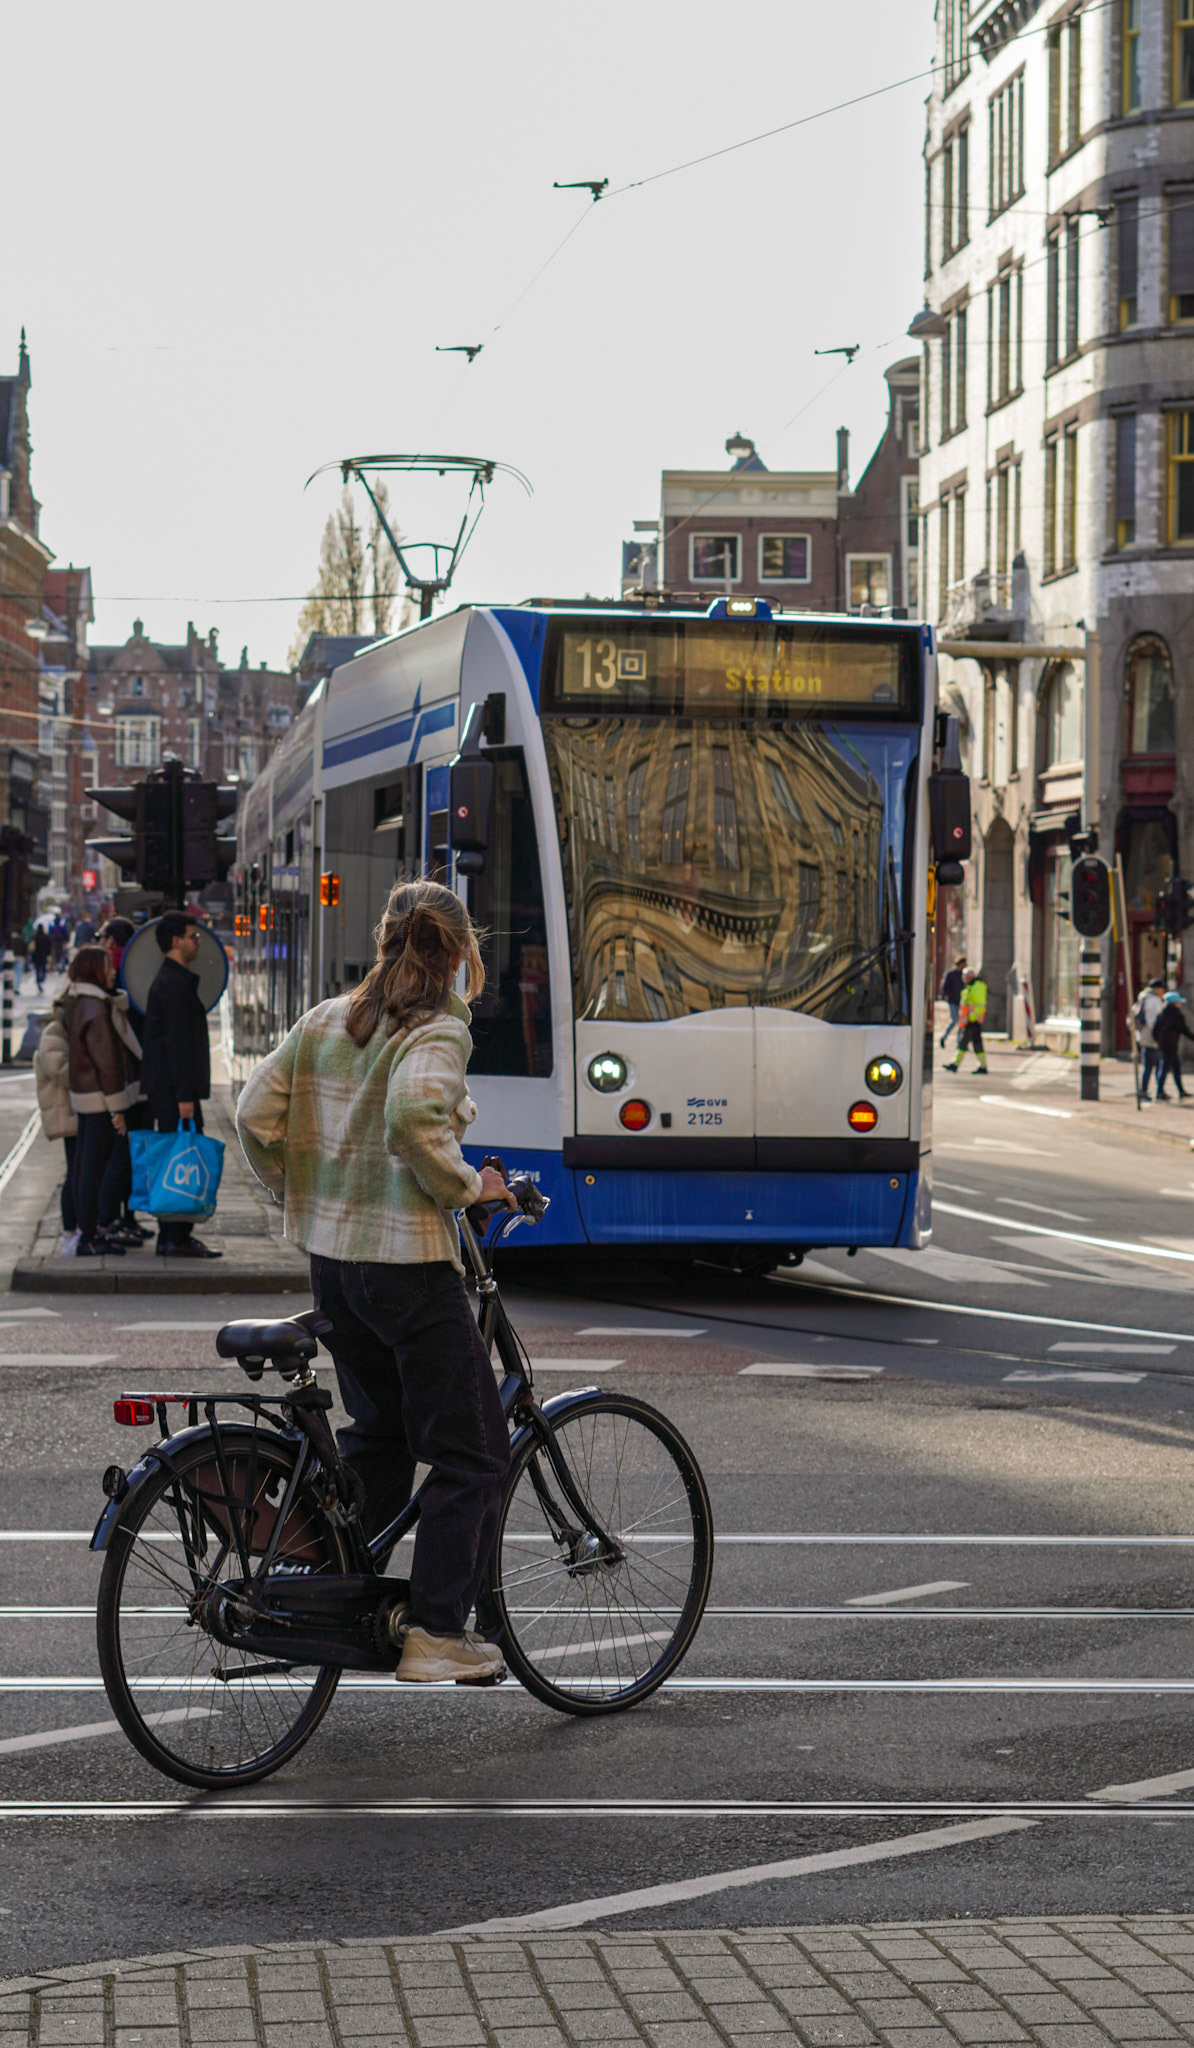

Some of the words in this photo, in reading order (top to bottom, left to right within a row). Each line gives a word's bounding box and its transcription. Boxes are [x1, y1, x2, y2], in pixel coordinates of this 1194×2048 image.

[577, 639, 616, 689] 13
[725, 668, 822, 693] Station
[707, 1099, 728, 1107] GVB
[688, 1113, 723, 1125] 2125
